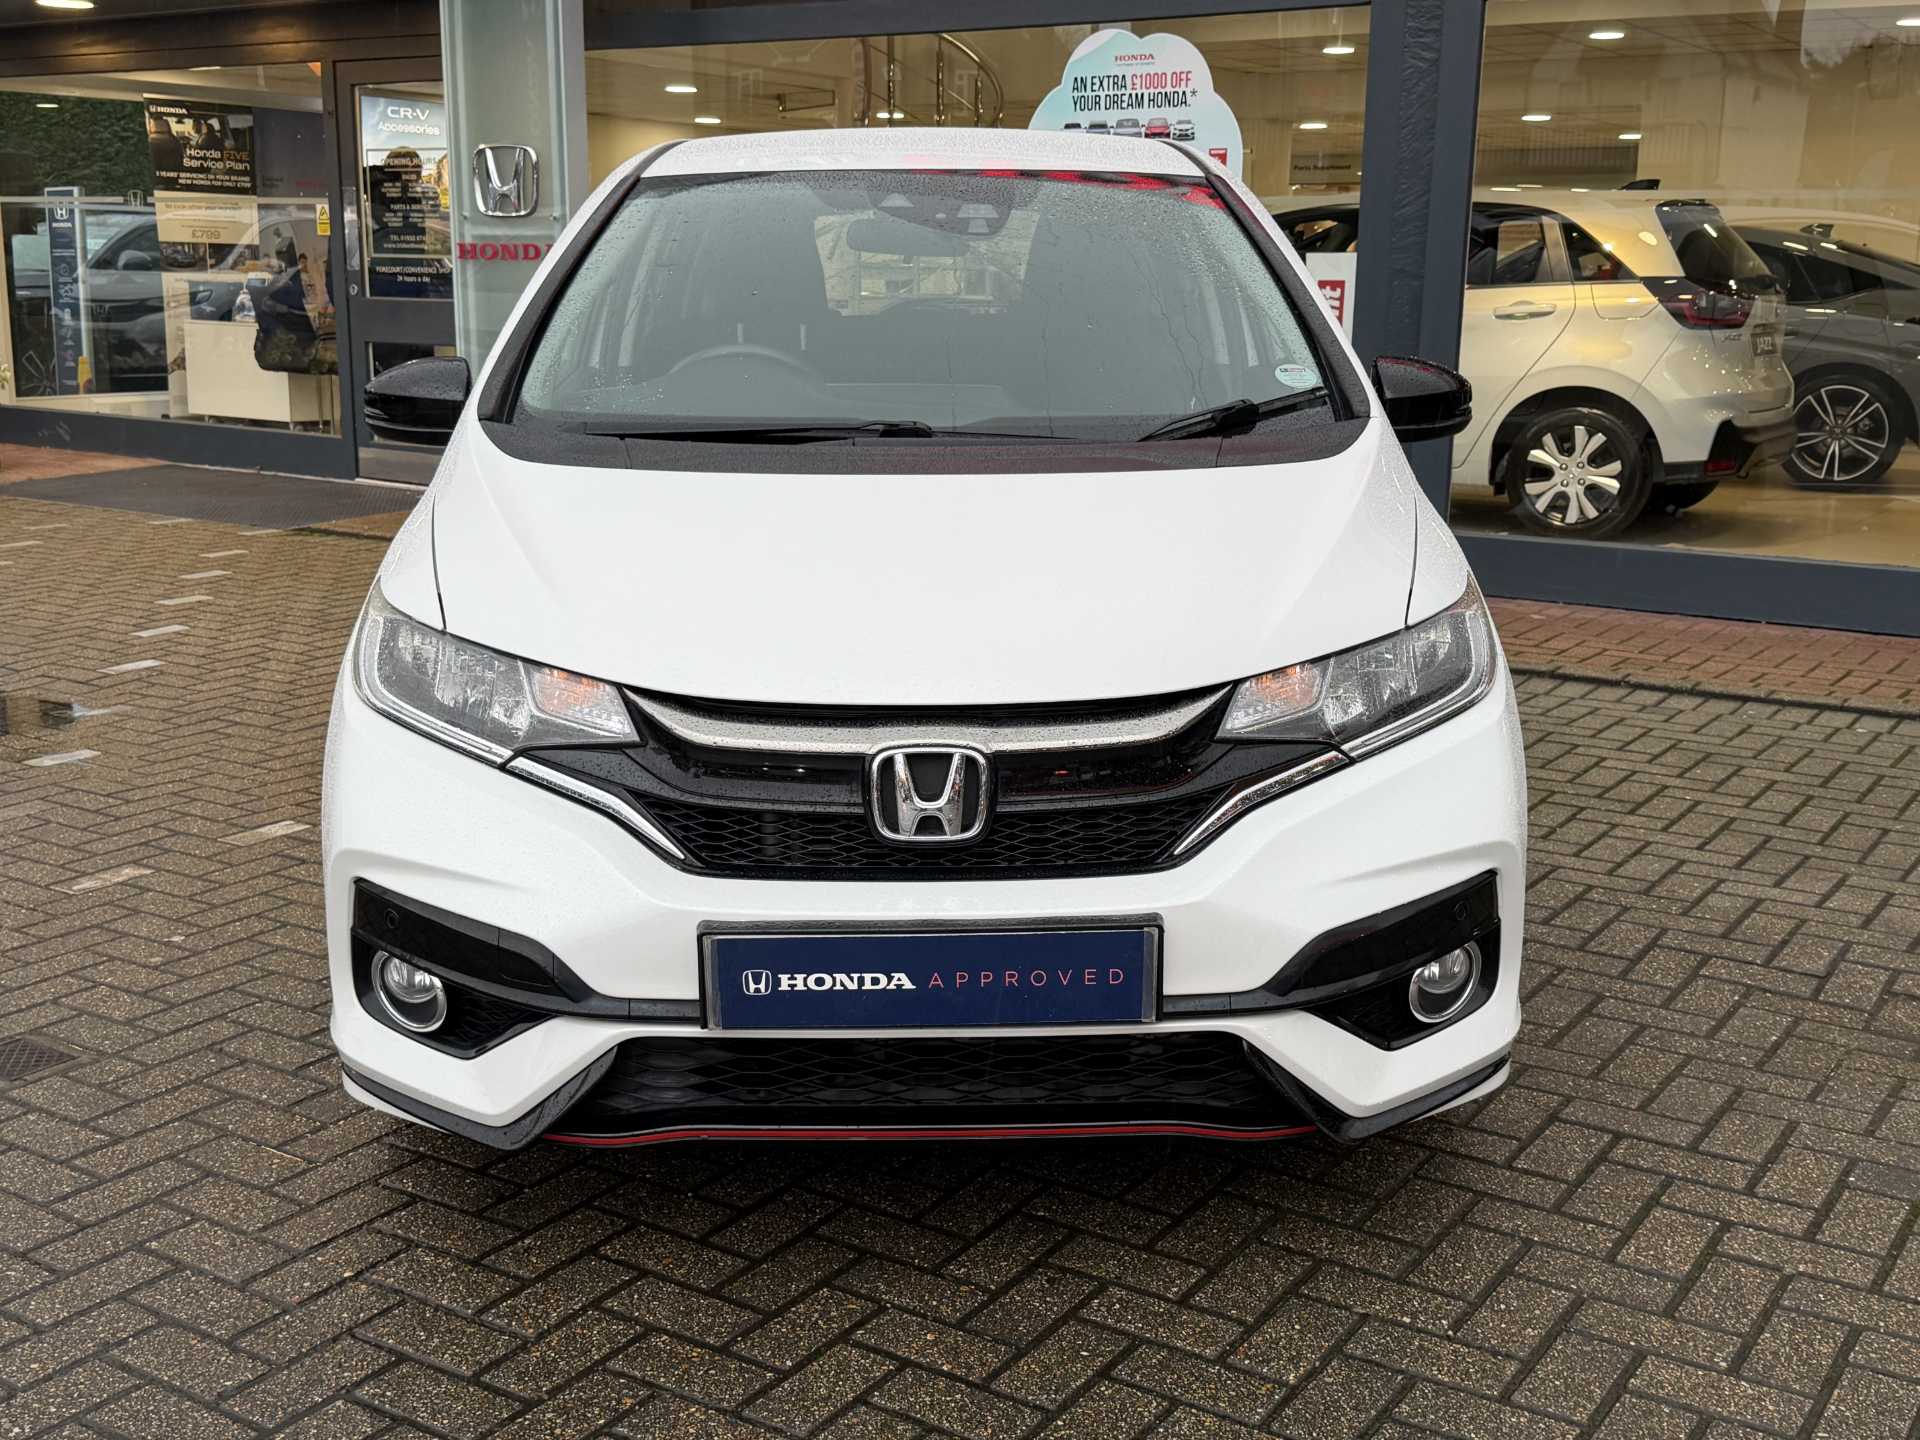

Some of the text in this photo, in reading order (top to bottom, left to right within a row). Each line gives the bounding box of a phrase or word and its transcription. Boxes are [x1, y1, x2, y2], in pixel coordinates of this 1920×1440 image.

[1114, 53, 1155, 62] HONDA
[1072, 71, 1193, 93] AN EXTRA £1000 OFF
[157, 106, 188, 114] HONDA
[1072, 94, 1101, 112] YOUR
[1104, 93, 1144, 110] DREAM
[377, 121, 440, 136] Accessories
[186, 148, 250, 161] Honda FIVE
[183, 158, 250, 171] Service Plan
[456, 242, 555, 260] HOND
[777, 968, 1125, 991] HONDA APPROVED
